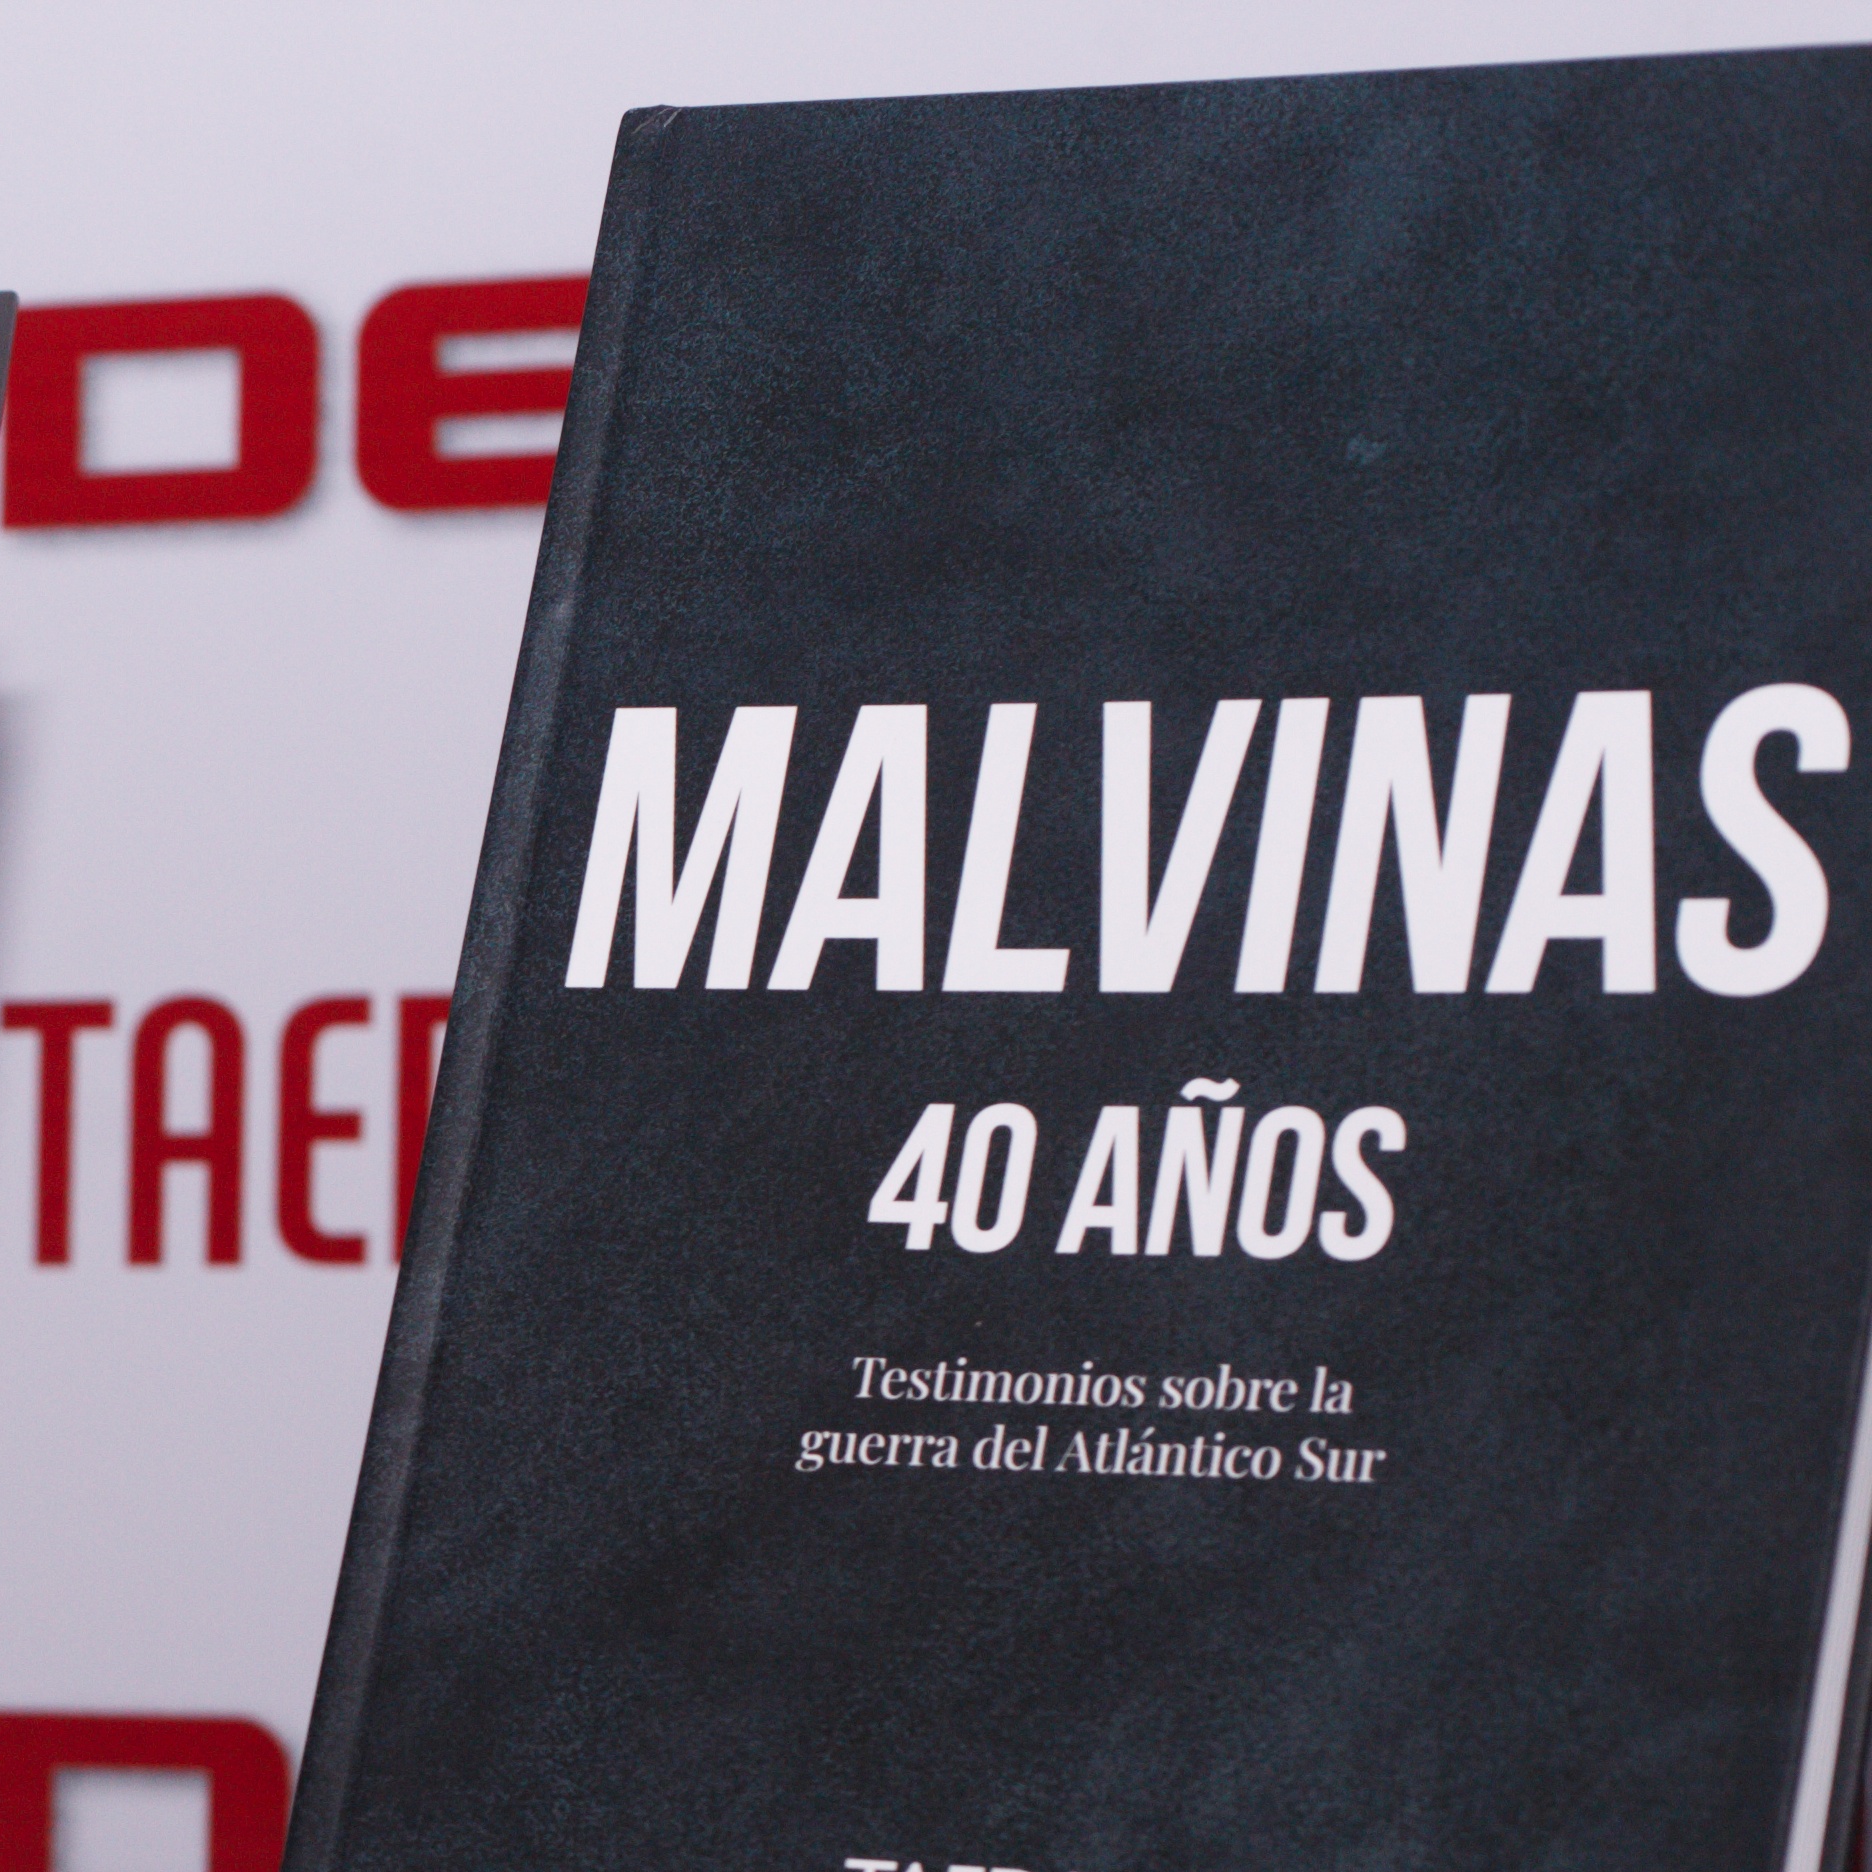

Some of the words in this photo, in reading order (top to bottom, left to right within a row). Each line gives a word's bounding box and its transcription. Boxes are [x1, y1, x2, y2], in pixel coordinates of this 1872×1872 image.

[563, 682, 1853, 998] MALVINAS
[866, 1100, 1040, 1256] 40
[1055, 1076, 1408, 1263] AÑOS
[852, 1355, 1148, 1411] Testimonios
[1160, 1363, 1298, 1415] sobre
[1311, 1366, 1355, 1416] la
[792, 1430, 960, 1476] guerra
[971, 1428, 1047, 1475] del
[1055, 1426, 1284, 1482] Atlántico
[1294, 1435, 1386, 1486] Sur
